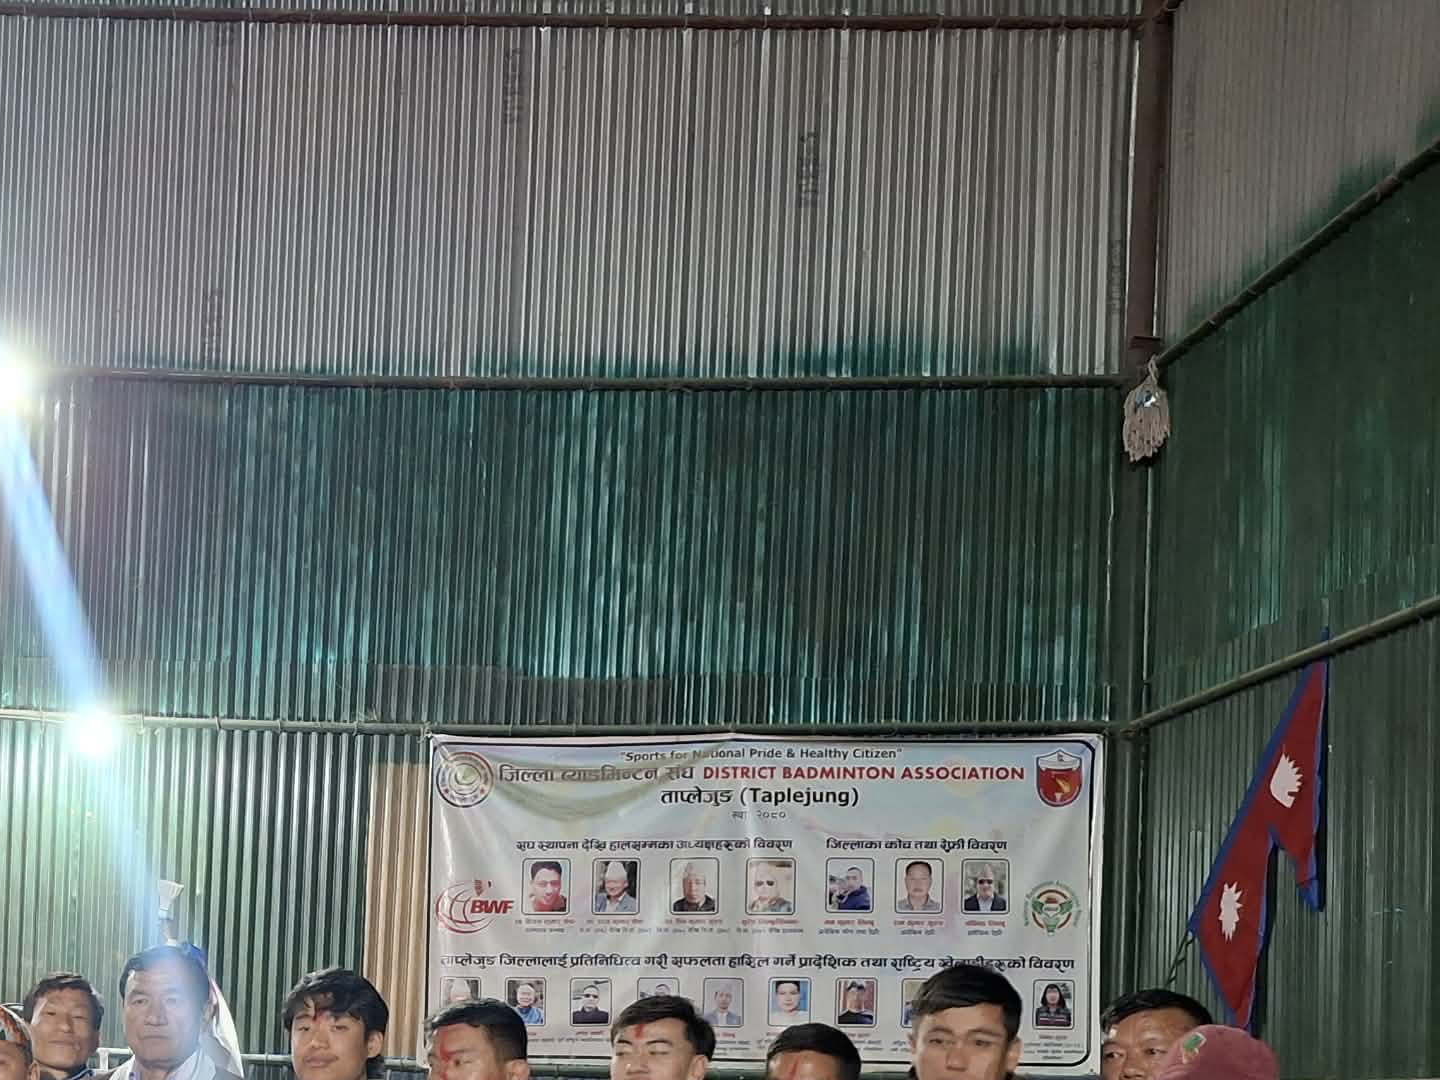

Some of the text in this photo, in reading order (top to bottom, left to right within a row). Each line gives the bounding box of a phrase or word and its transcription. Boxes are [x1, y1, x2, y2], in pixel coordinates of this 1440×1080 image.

[670, 750, 687, 760] for
[692, 748, 744, 760] National
[749, 748, 783, 759] Pride
[786, 748, 795, 759] &
[799, 747, 848, 761] Healthy
[499, 764, 554, 782] जिल्ला
[703, 766, 777, 780] DISTRICT
[782, 766, 895, 780] BADMINTON
[900, 766, 1026, 781] ASSOCIATION
[740, 786, 860, 808] (Taplejung)
[538, 840, 579, 852] स्थापना
[581, 838, 607, 852] देखि
[753, 837, 793, 853] विवरण
[826, 837, 882, 851] जिल्लाका
[915, 840, 938, 850] तथा
[967, 838, 1007, 854] विवरण
[470, 899, 515, 915] BWF
[499, 952, 569, 969] जिल्लालाई
[644, 953, 668, 969] गरी
[671, 955, 725, 969] सफलता
[728, 953, 769, 969] हासिल
[798, 953, 858, 970] प्रादेशिक
[860, 956, 887, 969] तथा
[1029, 955, 1075, 973] विवरण
